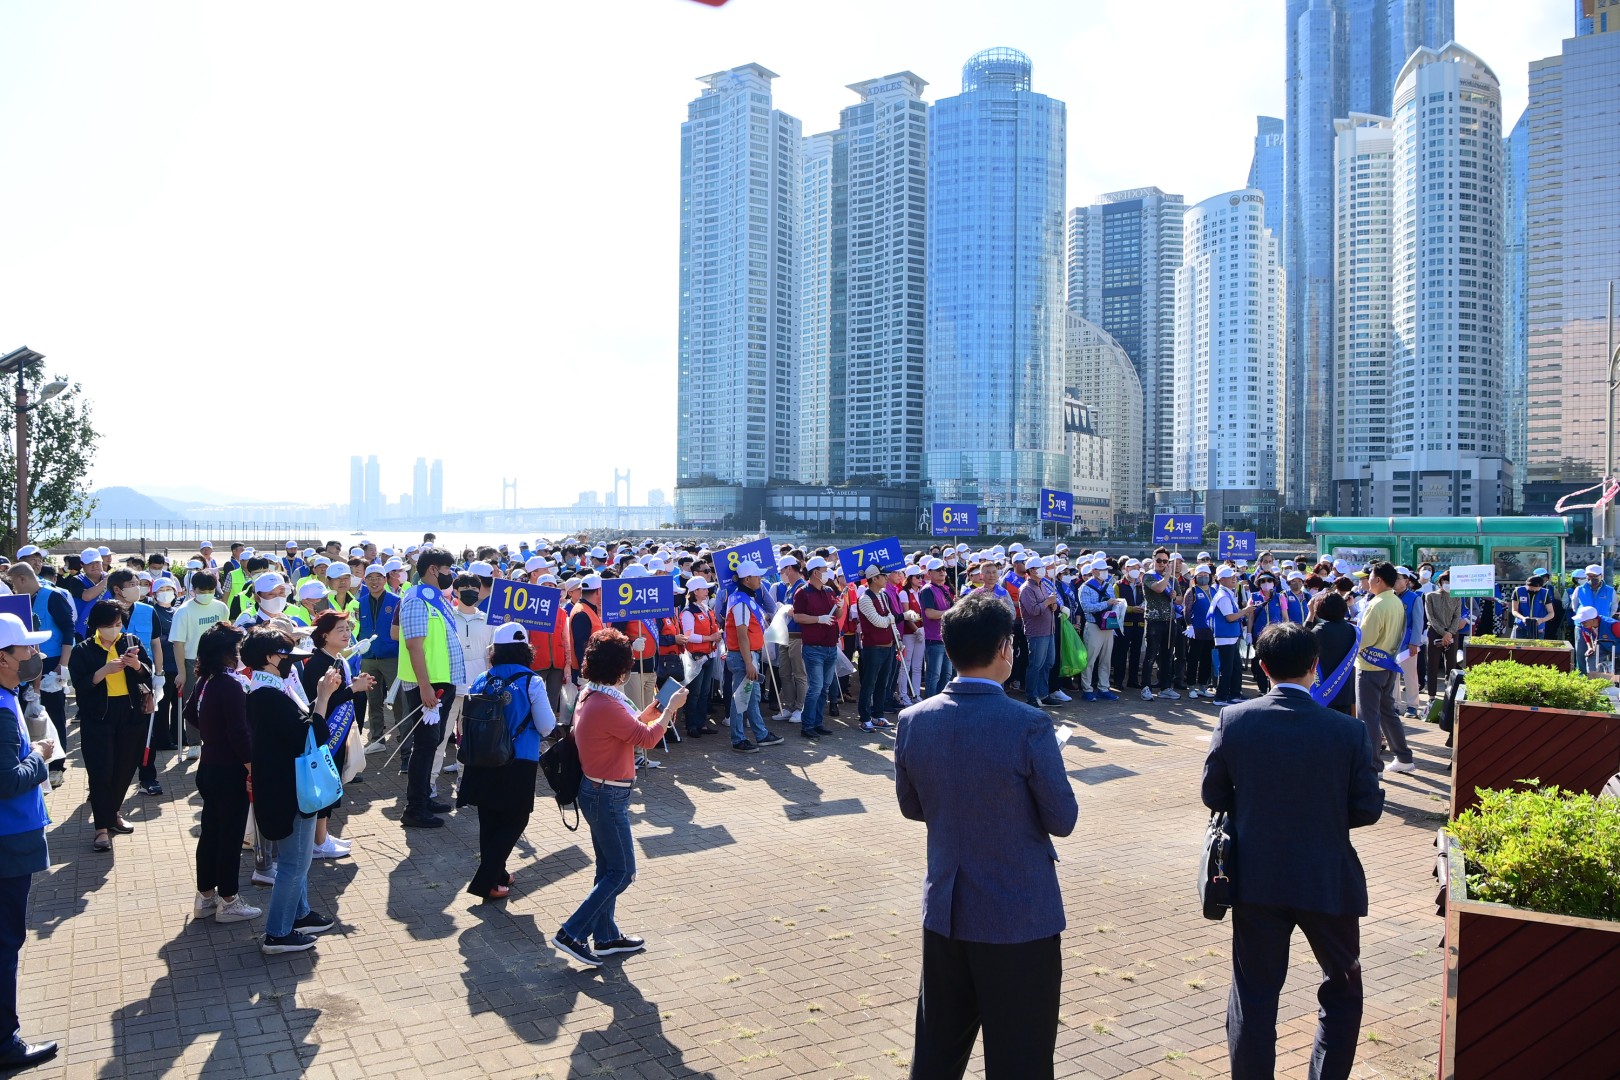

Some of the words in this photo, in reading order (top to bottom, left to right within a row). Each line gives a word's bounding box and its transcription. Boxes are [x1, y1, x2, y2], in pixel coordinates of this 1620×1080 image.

[1048, 493, 1066, 512] 5지역
[942, 506, 968, 524] 6지역
[1164, 518, 1192, 534] 4지역
[1226, 534, 1248, 550] 3지역
[504, 586, 551, 616] 10지역
[618, 582, 659, 606] 9지역
[1369, 650, 1388, 660] KOREA
[254, 672, 281, 689] CLEAN
[341, 705, 353, 727] CLEAN
[328, 727, 344, 749] KOREA
